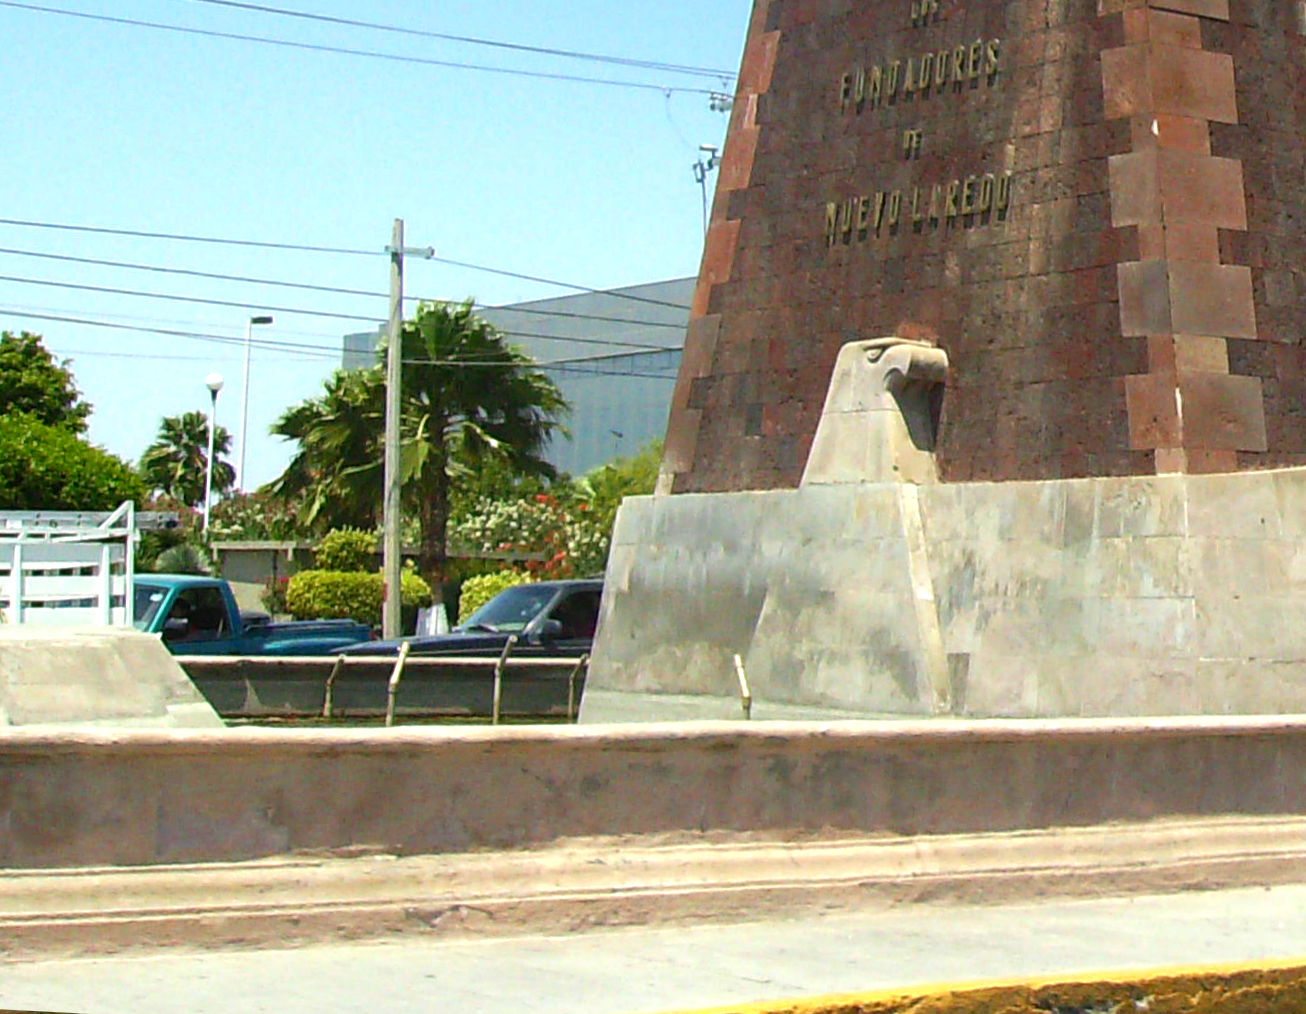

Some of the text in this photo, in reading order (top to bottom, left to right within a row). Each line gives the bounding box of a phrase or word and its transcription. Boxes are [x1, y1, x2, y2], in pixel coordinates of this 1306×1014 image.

[840, 38, 999, 103] FUNDADORES
[903, 128, 922, 149] DE
[826, 170, 1012, 237] NUEVO LAREDO
